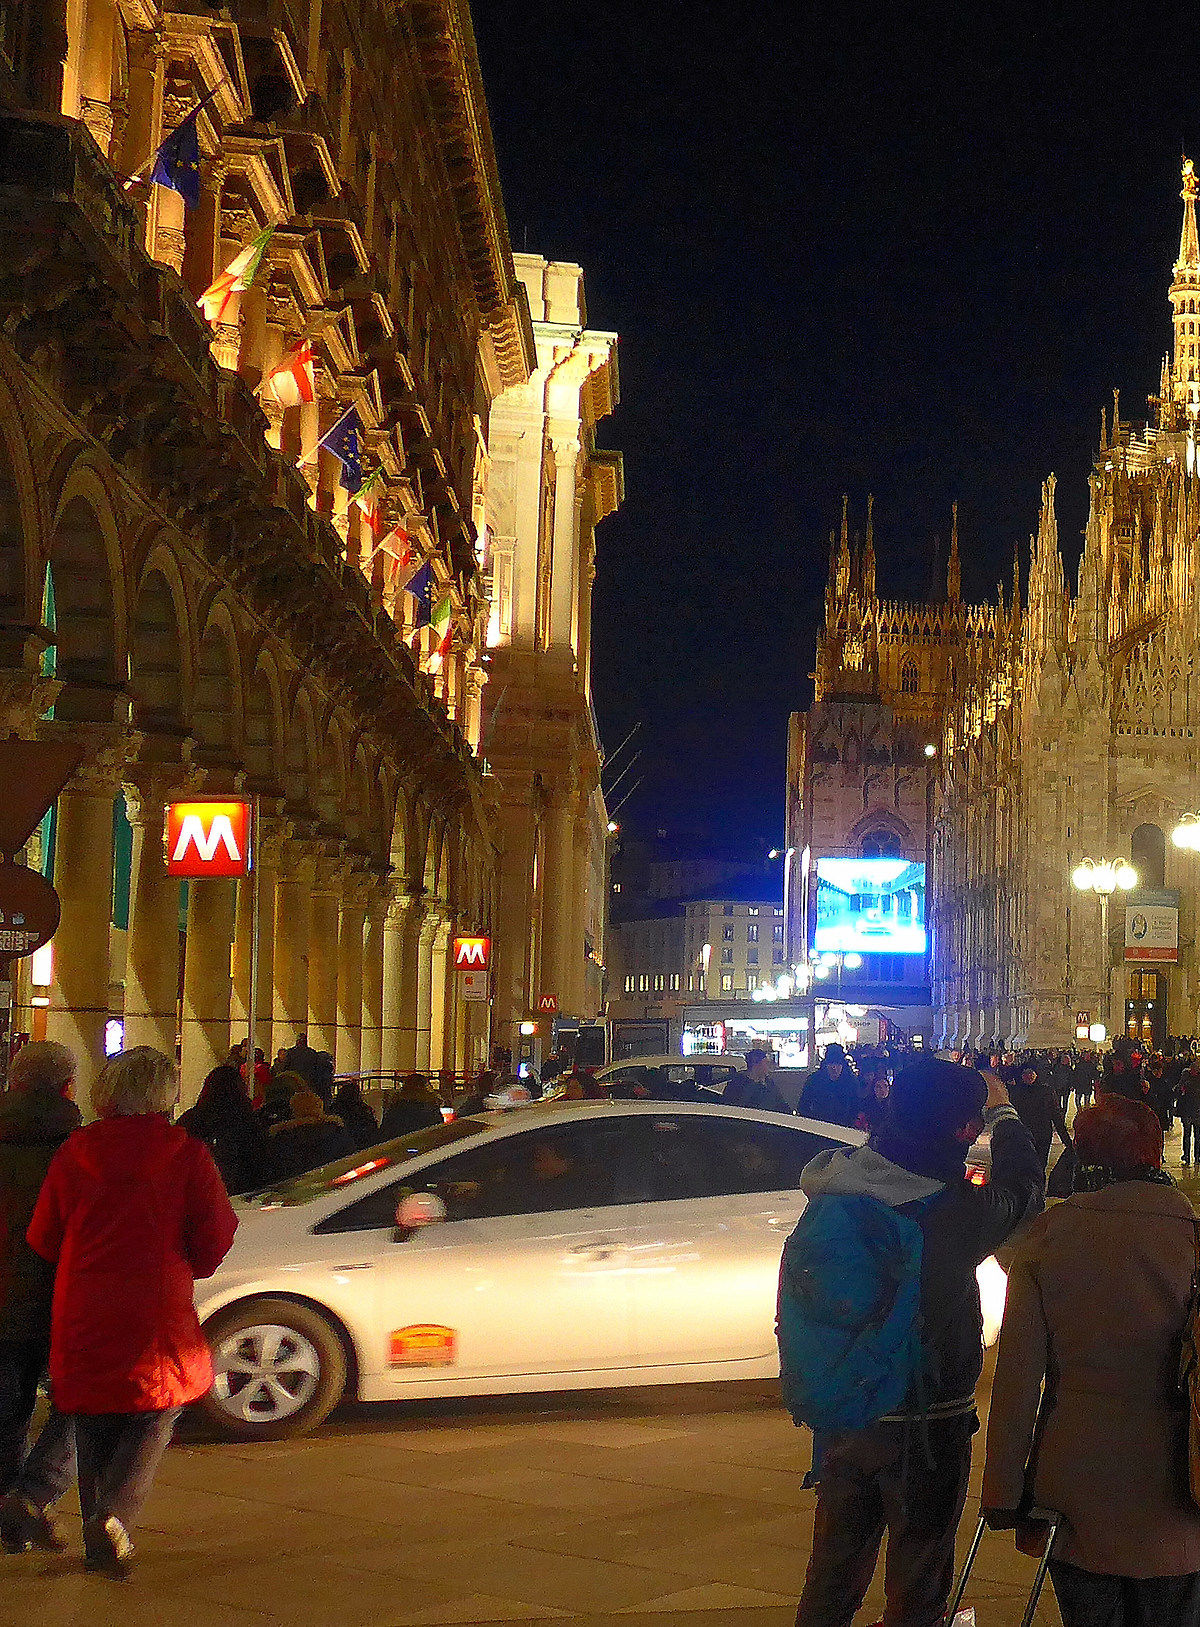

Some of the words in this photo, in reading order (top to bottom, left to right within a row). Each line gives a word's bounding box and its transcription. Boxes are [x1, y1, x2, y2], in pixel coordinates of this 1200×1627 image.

[173, 815, 241, 861] M
[457, 943, 485, 964] M
[541, 997, 556, 1008] M
